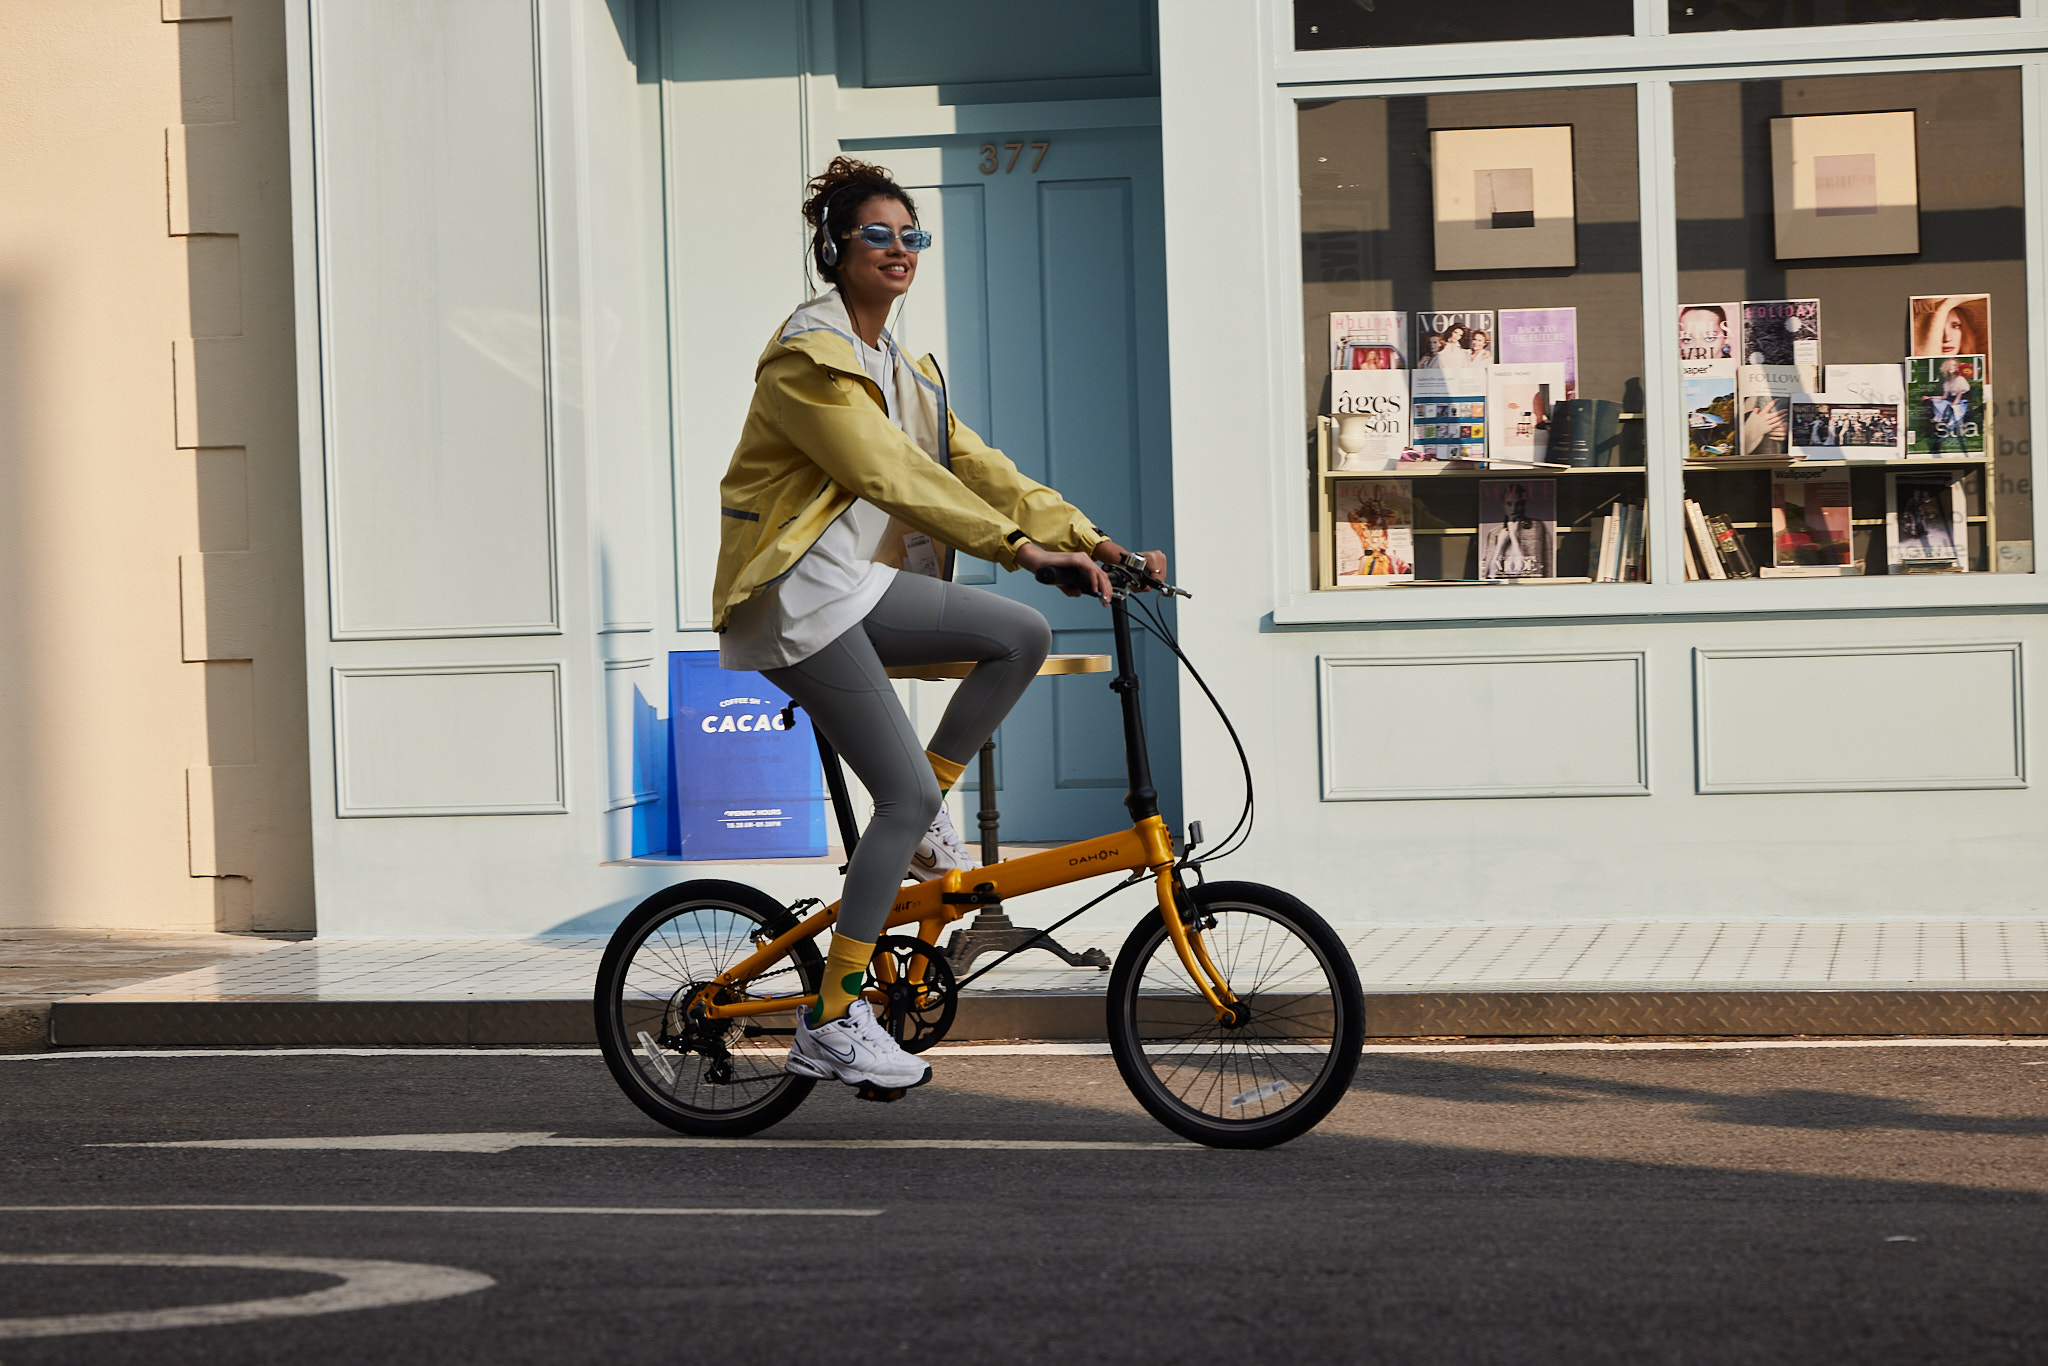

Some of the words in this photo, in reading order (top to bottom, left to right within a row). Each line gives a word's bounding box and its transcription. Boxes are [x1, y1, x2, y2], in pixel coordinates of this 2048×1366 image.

[979, 142, 1050, 174] 377
[1745, 304, 1816, 318] HOLIDAY
[1335, 317, 1403, 330] HOLIDAY
[1419, 313, 1493, 333] VOGUE
[1907, 356, 1983, 384] ELLE
[1748, 373, 1801, 384] FOLLOW
[1338, 390, 1401, 413] âges
[1364, 420, 1400, 434] son
[1340, 485, 1409, 497] HOLIDAY
[1068, 849, 1119, 866] DAHON
